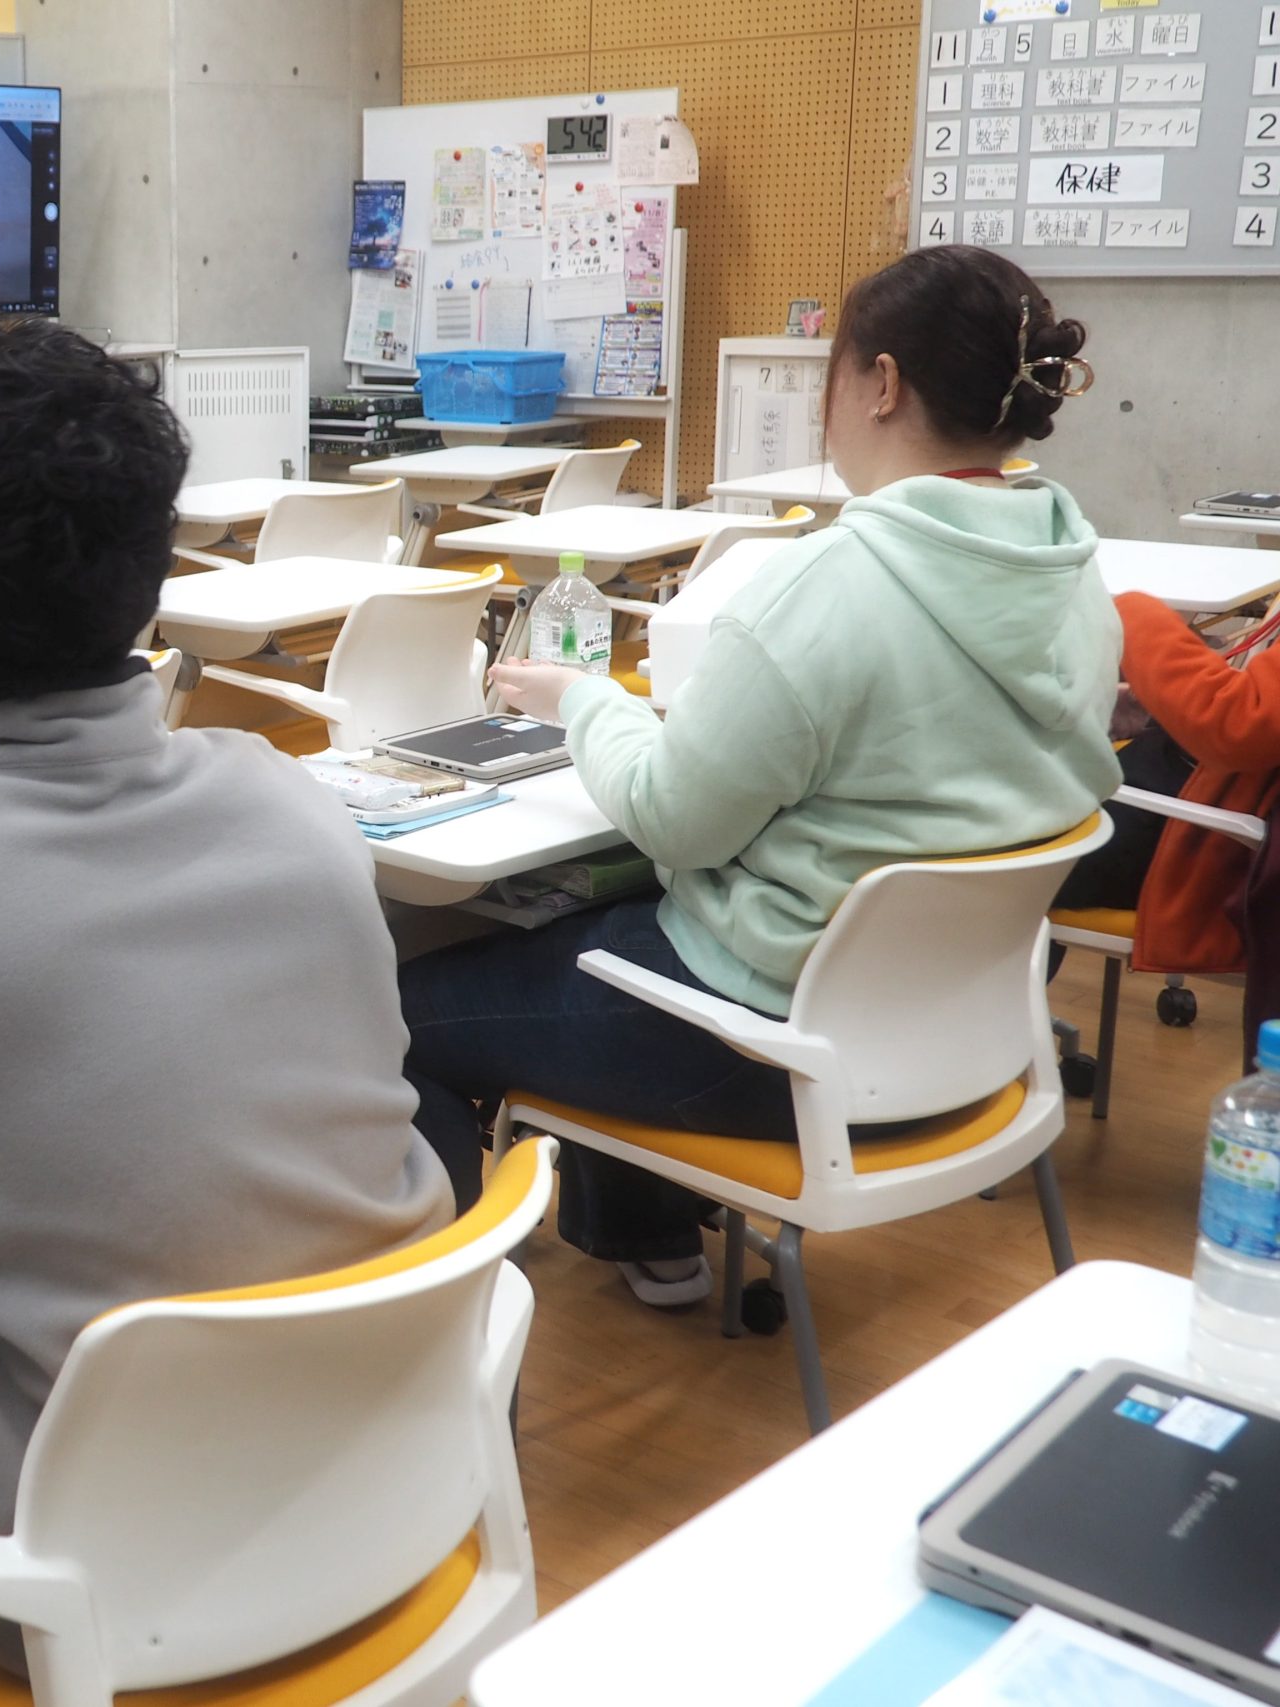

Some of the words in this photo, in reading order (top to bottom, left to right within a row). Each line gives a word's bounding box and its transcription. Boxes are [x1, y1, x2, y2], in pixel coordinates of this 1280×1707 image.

[1016, 32, 1031, 54] 5
[1063, 33, 1076, 50] 日
[1105, 28, 1123, 47] 水
[1151, 25, 1189, 45] 曜日
[936, 34, 958, 61] 11
[980, 38, 994, 58] 月
[981, 82, 1014, 100] 理科
[1049, 76, 1103, 97] 教科書
[1125, 73, 1201, 92] ファイル
[942, 81, 948, 105] 1
[975, 128, 1010, 145] 数学
[1043, 123, 1097, 143] 教科書
[1120, 119, 1195, 136] ファイル
[1256, 113, 1277, 140] 2
[935, 126, 952, 151] 2
[931, 171, 948, 196] 3
[1055, 162, 1121, 195] 保健
[1250, 162, 1271, 189] 3
[928, 217, 946, 241] 4
[971, 219, 1005, 238] 英語
[1035, 218, 1088, 238] 教科書
[1110, 219, 1185, 236] ファイル
[1244, 213, 1266, 239] 4
[760, 367, 771, 384] 7
